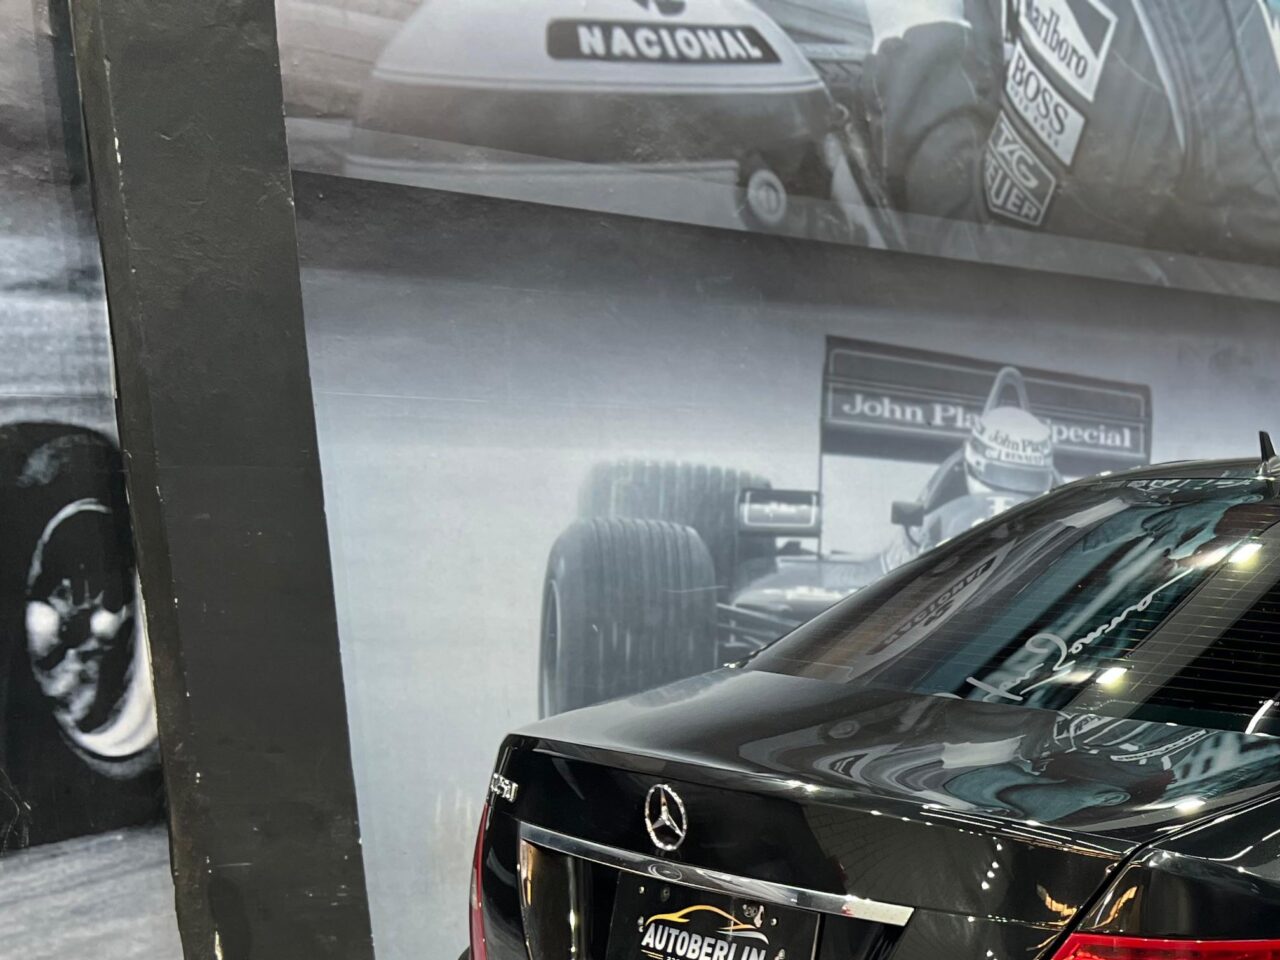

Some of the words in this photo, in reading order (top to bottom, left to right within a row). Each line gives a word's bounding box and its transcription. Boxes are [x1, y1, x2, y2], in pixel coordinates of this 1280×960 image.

[576, 23, 764, 60] NACIONAL
[1027, 0, 1089, 79] arlboro
[1012, 51, 1068, 136] BOSS
[842, 394, 924, 425] John
[932, 403, 979, 429] Pla
[1046, 420, 1132, 448] pecial
[988, 430, 1020, 452] John
